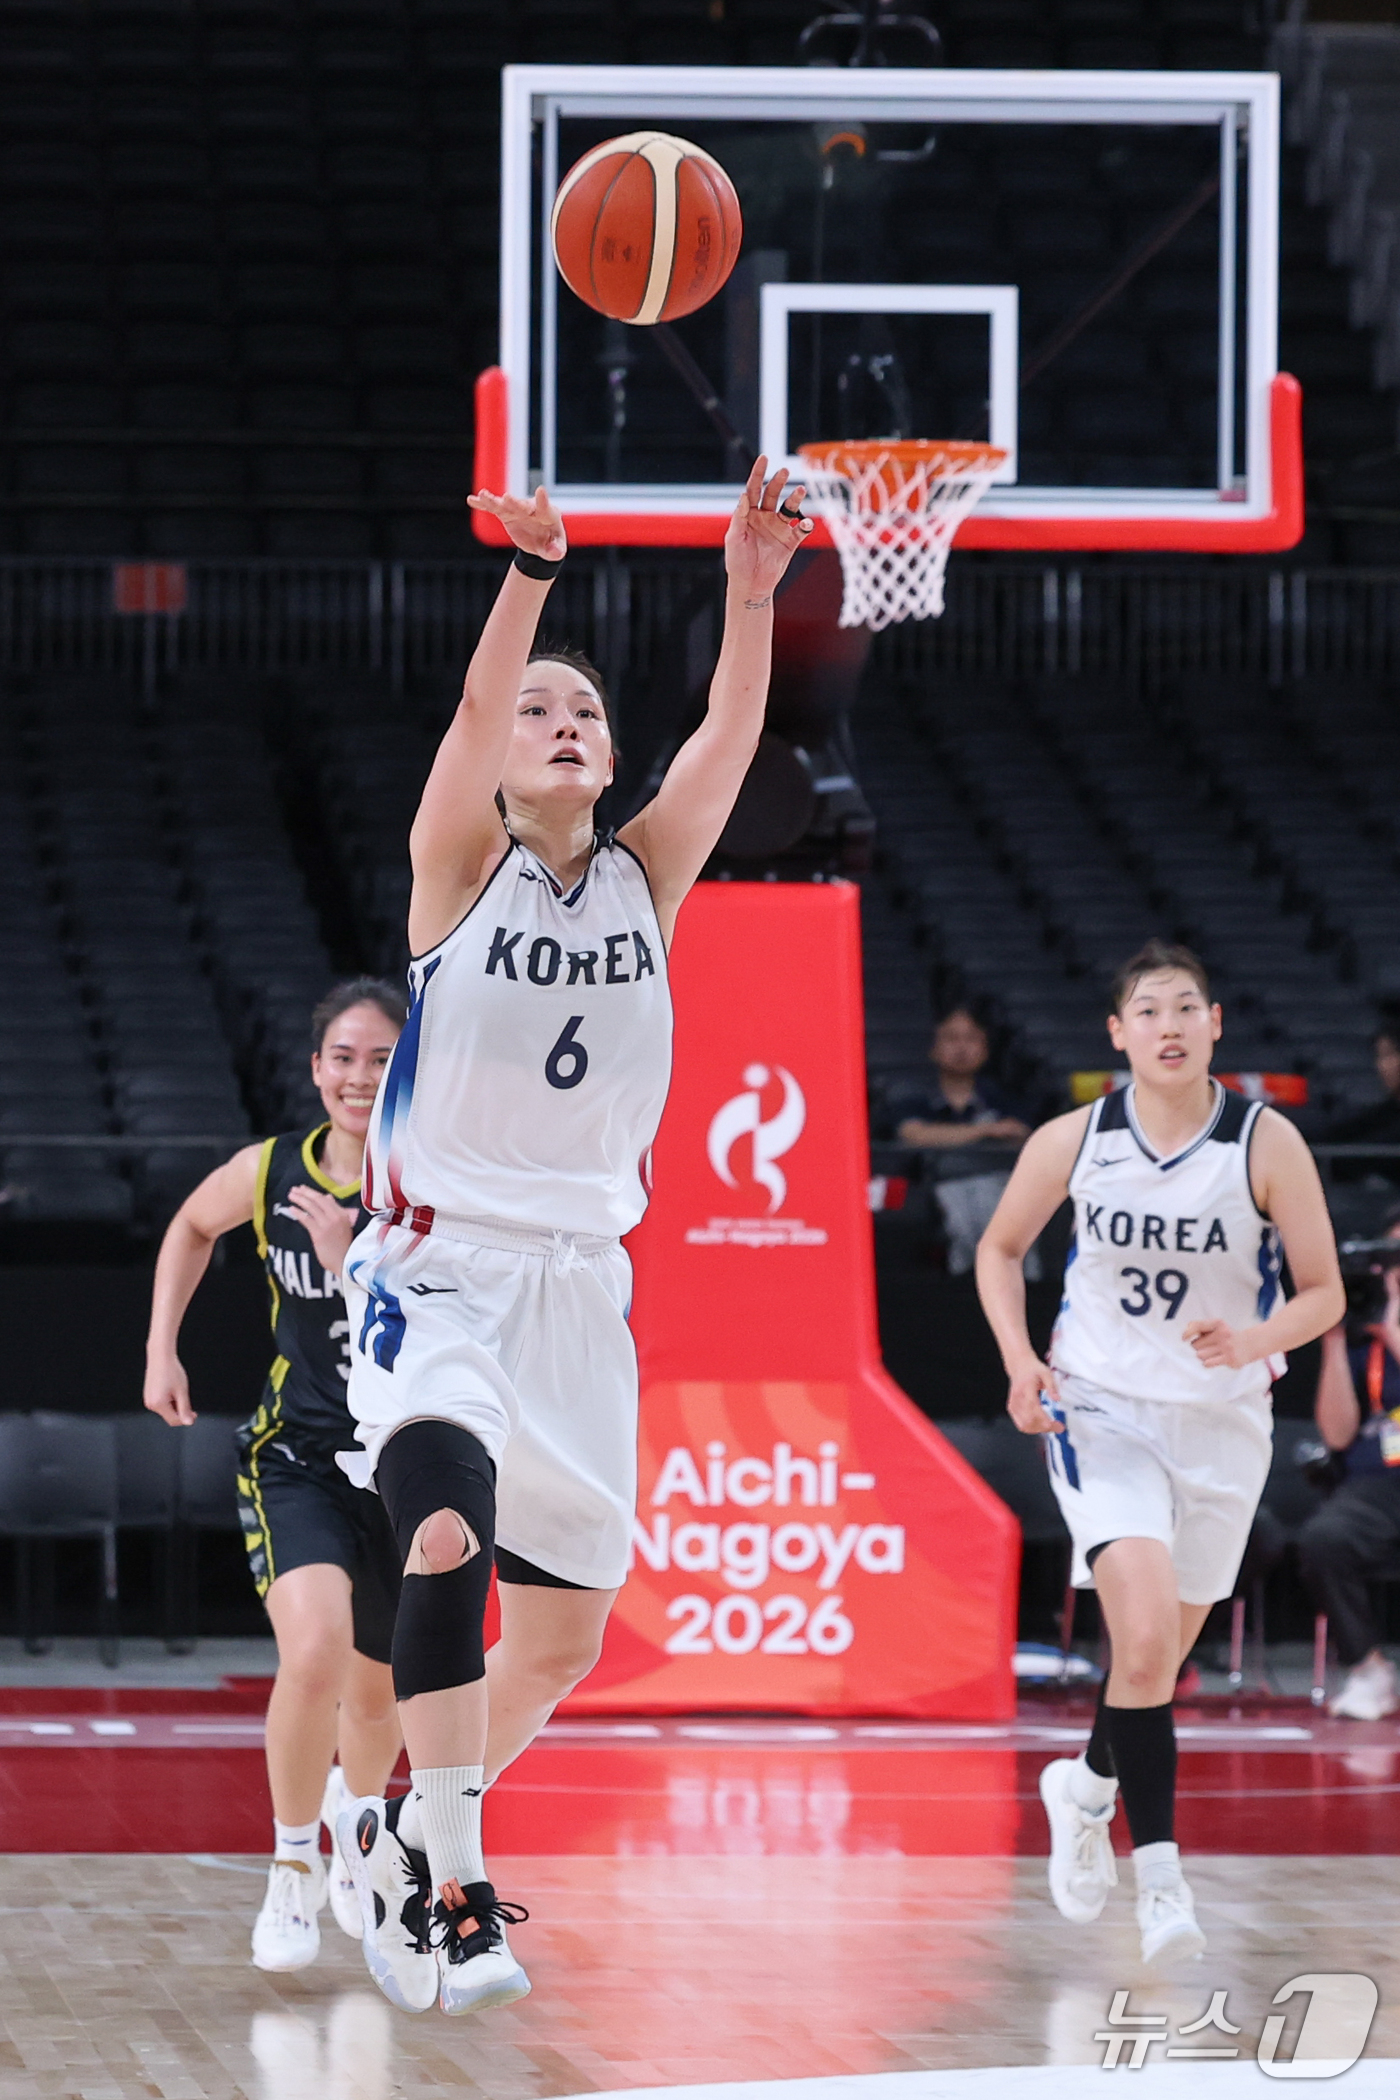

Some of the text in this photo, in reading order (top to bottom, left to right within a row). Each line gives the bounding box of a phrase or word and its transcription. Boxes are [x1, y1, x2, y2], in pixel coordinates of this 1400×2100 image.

[485, 926, 655, 986] KOREA
[545, 1016, 588, 1090] 6
[1087, 1202, 1228, 1253] KOREA
[1120, 1267, 1188, 1320] 39
[652, 1440, 876, 1507] Aichi-
[628, 1513, 905, 1590] Nagoya
[665, 1594, 854, 1655] 2026
